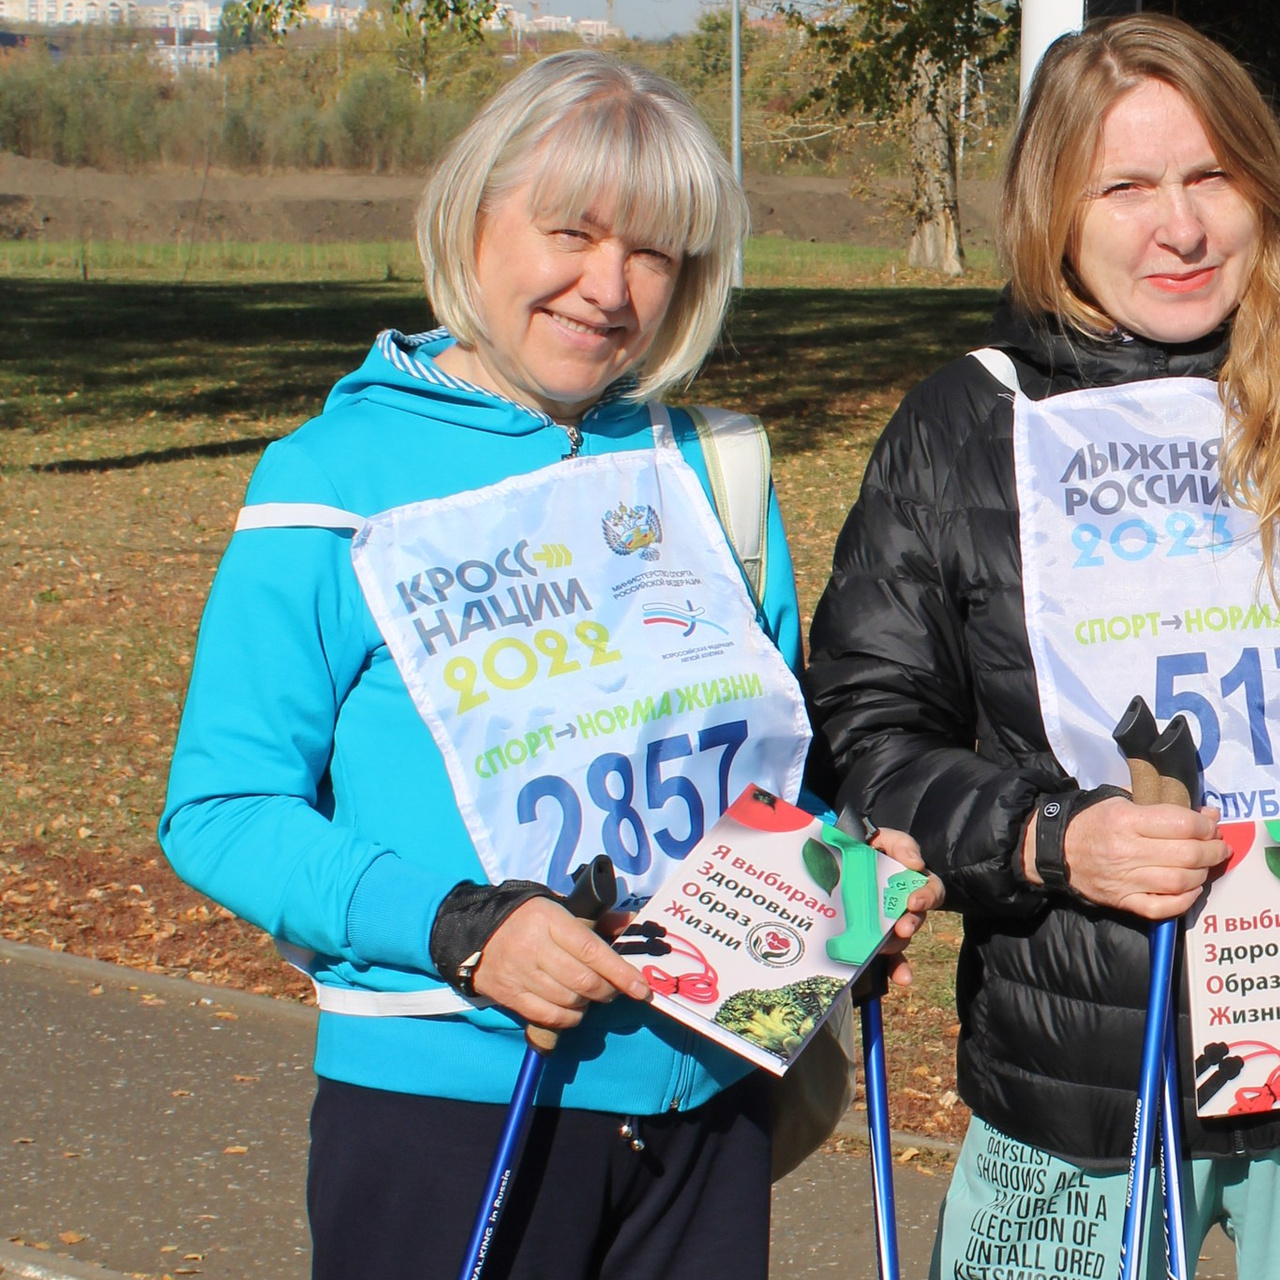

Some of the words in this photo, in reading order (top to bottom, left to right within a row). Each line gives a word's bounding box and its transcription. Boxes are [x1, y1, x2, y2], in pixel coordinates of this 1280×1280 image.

[1059, 437, 1222, 484] ЛЫЖНЯ
[1065, 473, 1230, 516] РОССИИ
[396, 539, 536, 614] КРОСС
[413, 577, 592, 656] НАЦИИ
[1075, 611, 1160, 646] СПОРТ
[444, 620, 623, 715] 2022
[474, 723, 556, 779] СПОРТ
[578, 692, 671, 740] НОРМА
[675, 673, 764, 715] ЖИЗНИ
[517, 720, 749, 898] 2857
[681, 882, 752, 927] Образ
[697, 861, 814, 932] Здоровый
[712, 844, 732, 859] Я
[732, 856, 837, 919] выбираю
[664, 900, 742, 951] Жизни
[1203, 915, 1218, 934] Я
[1130, 1098, 1142, 1157] WALKING
[489, 1209, 498, 1222] in
[494, 1169, 511, 1208] Russia
[1053, 1167, 1090, 1193] ALL
[1126, 1158, 1136, 1208] NORDIC
[970, 1208, 1065, 1243] LLECTION
[1072, 1220, 1099, 1247] OF
[1067, 1191, 1088, 1217] IN
[1095, 1194, 1107, 1221] A
[1054, 1246, 1105, 1279] ORED
